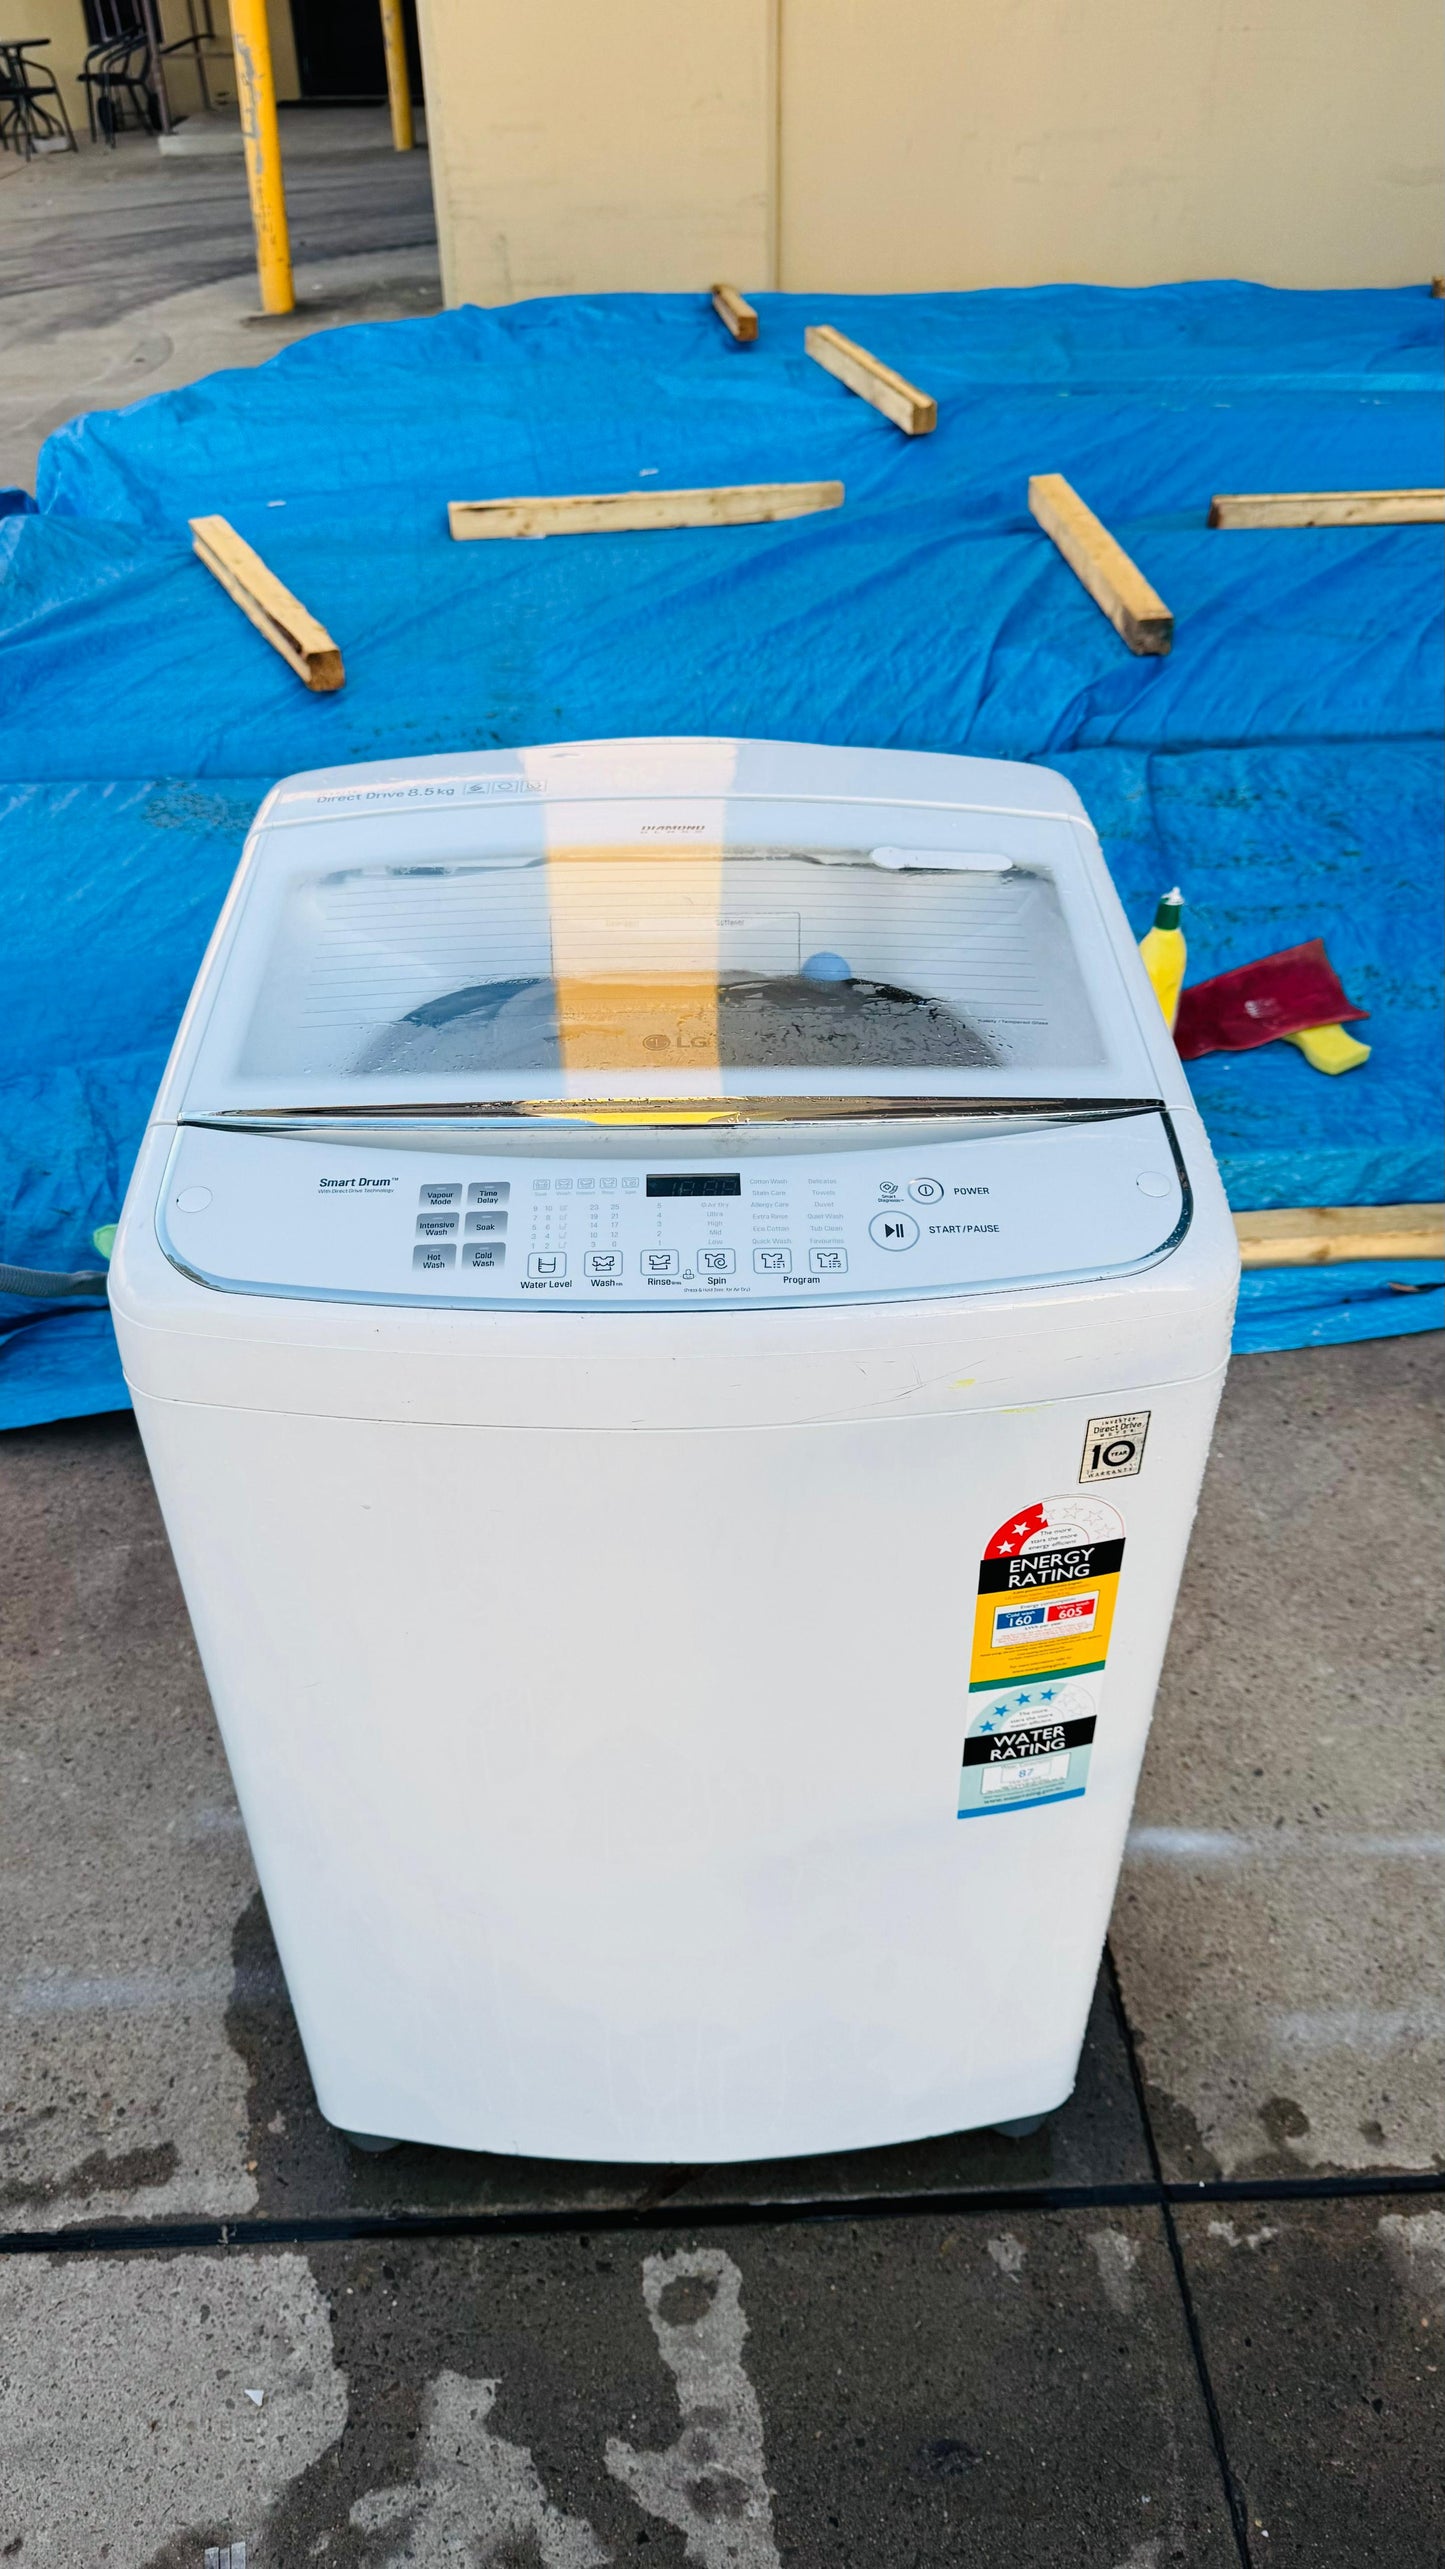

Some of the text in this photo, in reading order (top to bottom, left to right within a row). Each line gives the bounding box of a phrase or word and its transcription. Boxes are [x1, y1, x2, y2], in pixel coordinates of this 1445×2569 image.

[317, 793, 361, 804] Direct
[366, 791, 404, 801] Drive
[319, 1178, 356, 1188] Smart
[426, 1191, 455, 1199] Vapour
[953, 1187, 990, 1196] POWER
[476, 1223, 496, 1231] Soak
[928, 1224, 1000, 1235] START/PAUSE
[426, 1253, 442, 1261] Hot
[474, 1251, 494, 1260] Cold
[422, 1261, 446, 1269] Wash
[472, 1260, 496, 1268] Wash
[520, 1279, 573, 1289] Water Level
[590, 1278, 615, 1287] Wash
[647, 1277, 672, 1286] Rinse
[707, 1276, 727, 1286] Spin
[783, 1275, 821, 1285] Program
[1094, 1421, 1142, 1434] Direct Drive
[1092, 1440, 1136, 1470] 10
[1009, 1547, 1096, 1574] ENERGY
[1008, 1563, 1091, 1588] RATING
[1058, 1606, 1084, 1619] 605
[1009, 1615, 1033, 1627] 160
[994, 1726, 1066, 1747] WATER
[990, 1738, 1067, 1761] RATING
[1018, 1767, 1034, 1778] 87
